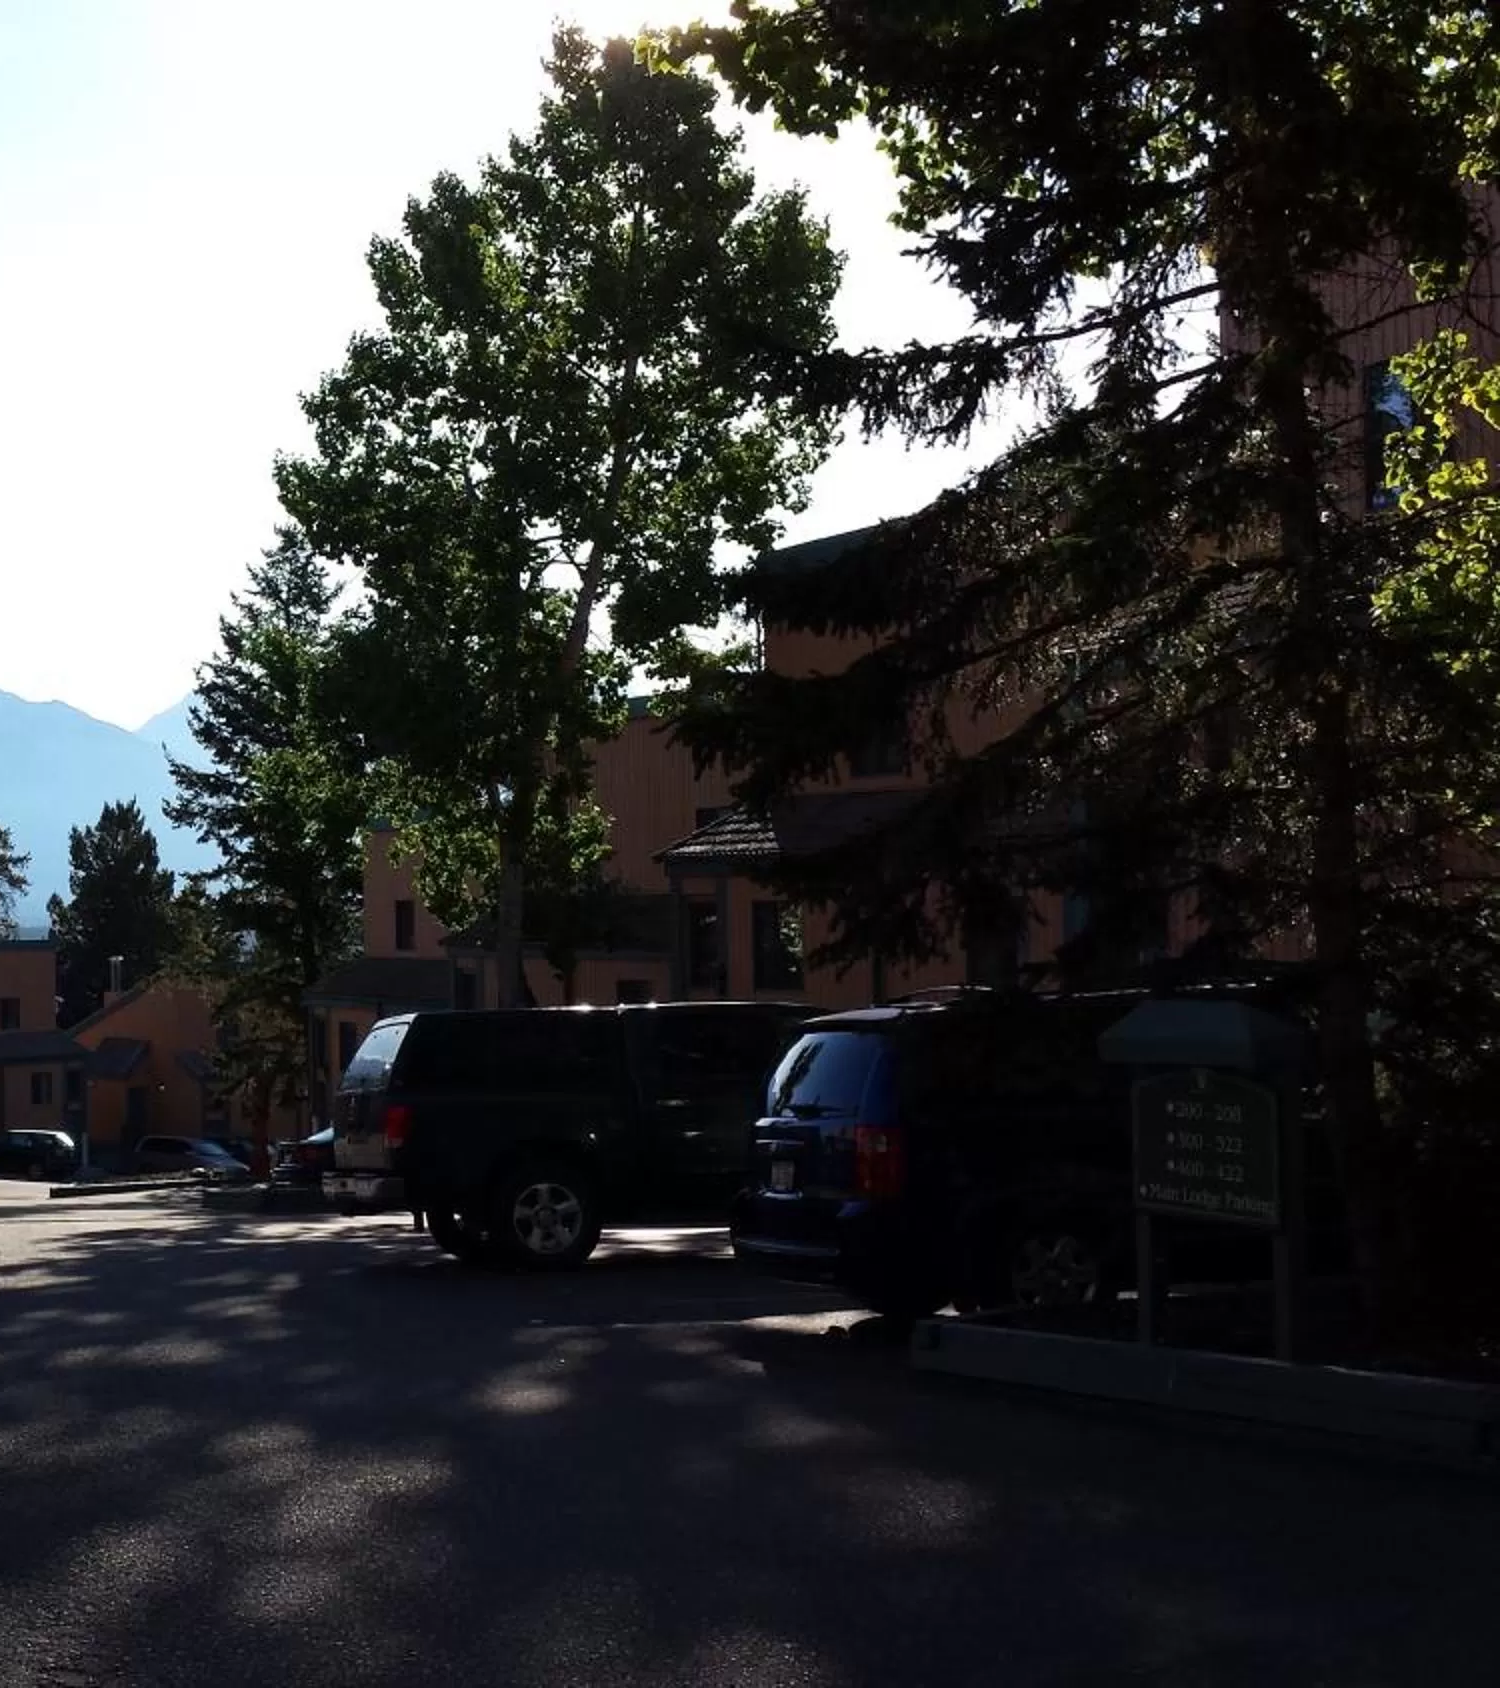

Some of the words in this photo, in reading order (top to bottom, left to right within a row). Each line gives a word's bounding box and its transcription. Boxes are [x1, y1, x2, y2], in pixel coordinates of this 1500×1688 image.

[1149, 1183, 1179, 1201] Main
[1182, 1187, 1221, 1210] Lodge
[1224, 1191, 1276, 1217] Parking
